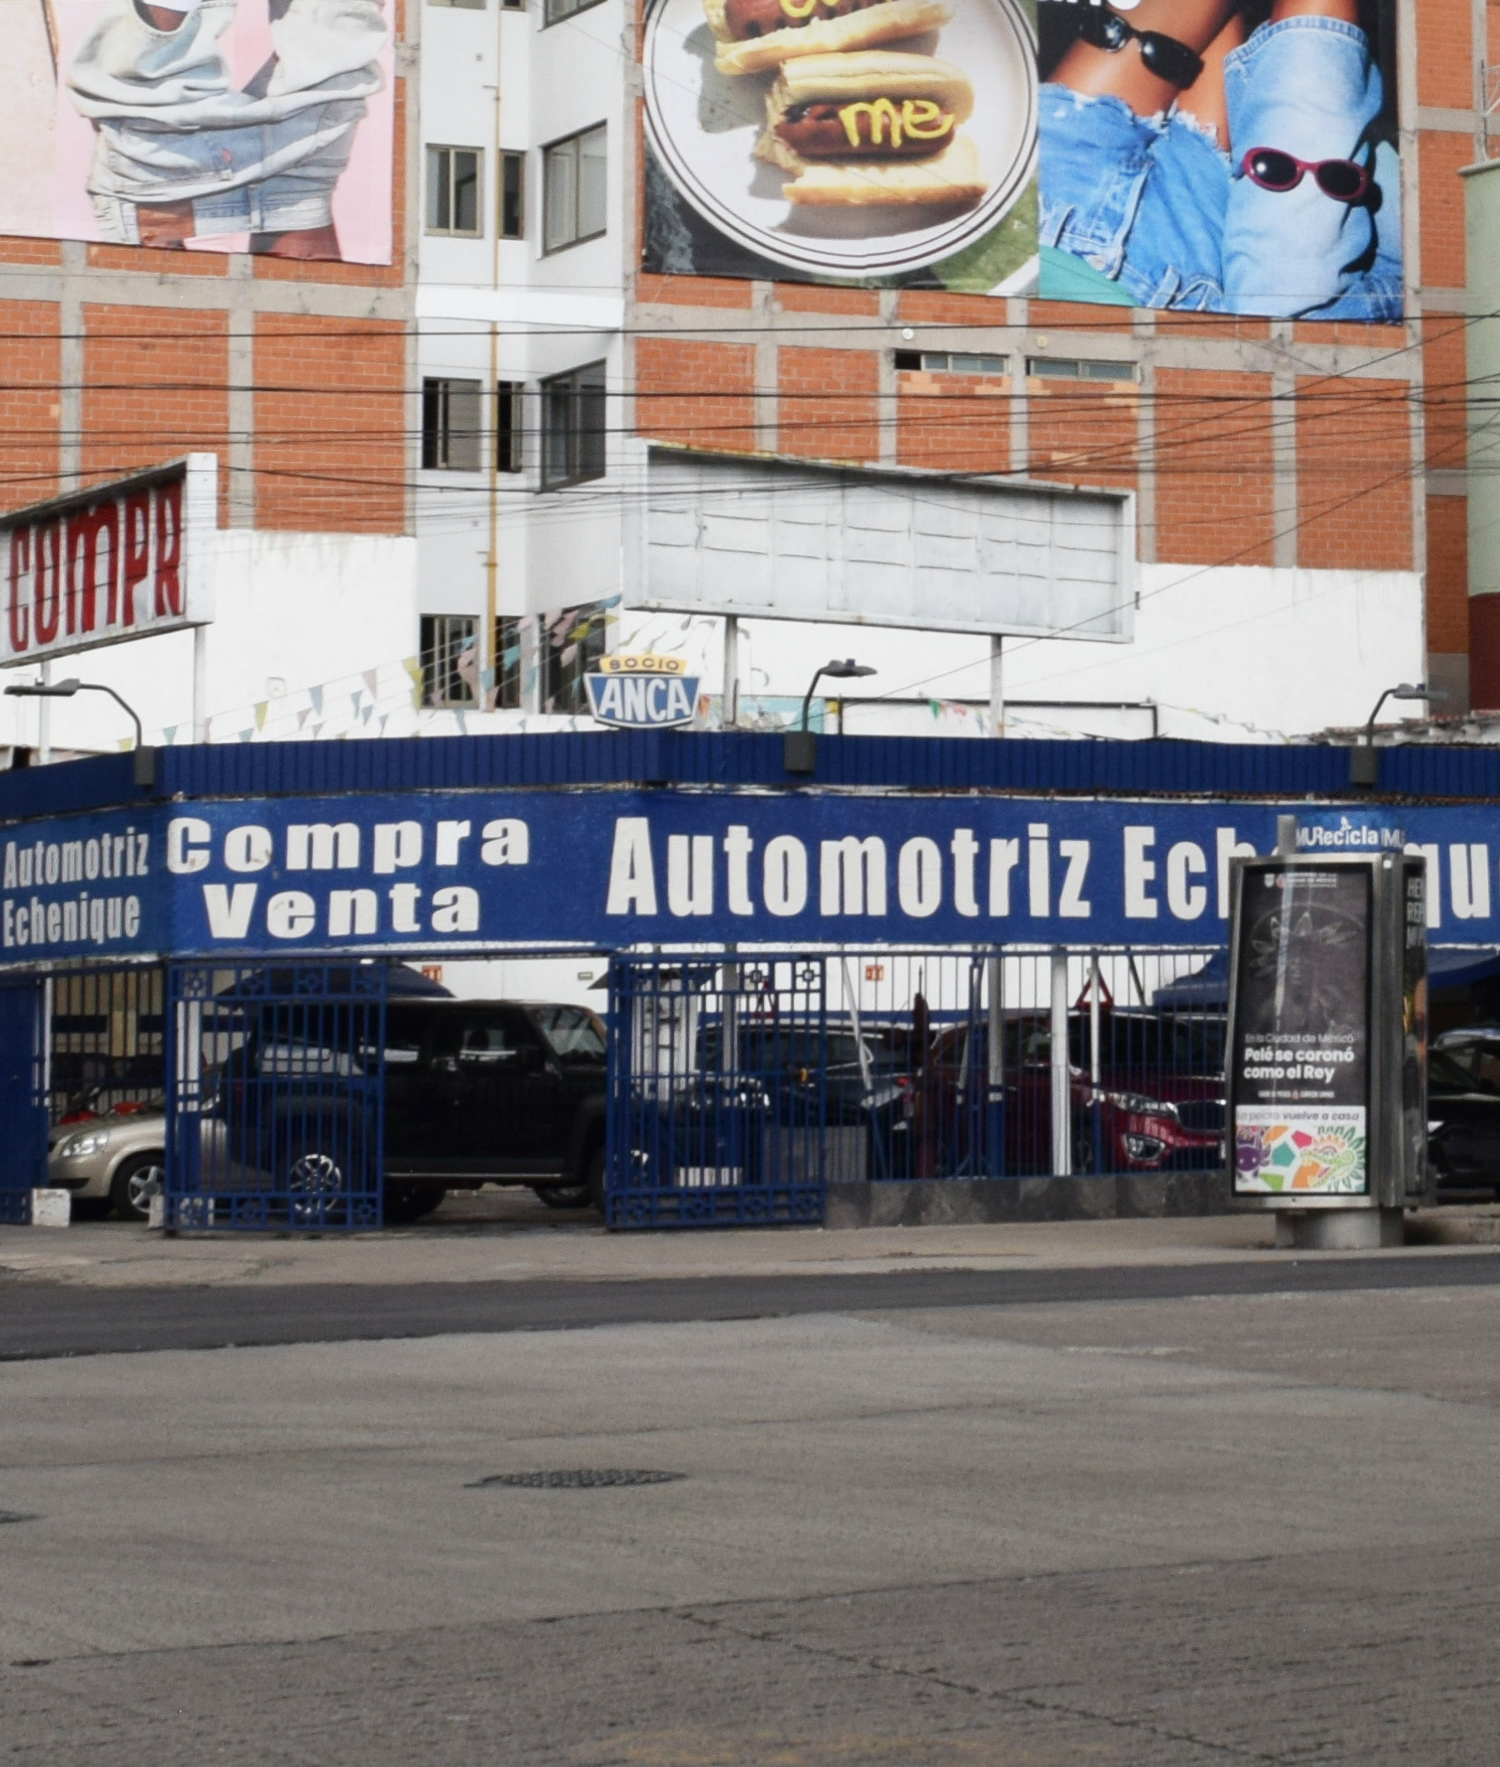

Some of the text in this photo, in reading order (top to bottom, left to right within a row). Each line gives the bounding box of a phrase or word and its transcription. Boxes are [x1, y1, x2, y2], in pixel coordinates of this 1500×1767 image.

[839, 98, 954, 148] me
[609, 657, 680, 671] SOCIO
[599, 678, 692, 722] ANCA
[3, 826, 150, 889] Automotriz
[166, 817, 530, 875] Compra
[606, 816, 1092, 920] Automotriz
[3, 891, 141, 948] Echenique
[203, 883, 481, 939] Venta
[1244, 1045, 1355, 1062] Pelé se coronó
[1265, 1033, 1301, 1043] Ciudad
[1303, 1033, 1316, 1043] de
[1318, 1032, 1354, 1043] México
[1243, 1064, 1335, 1084] como el Rey
[1283, 1111, 1319, 1120] vuelve
